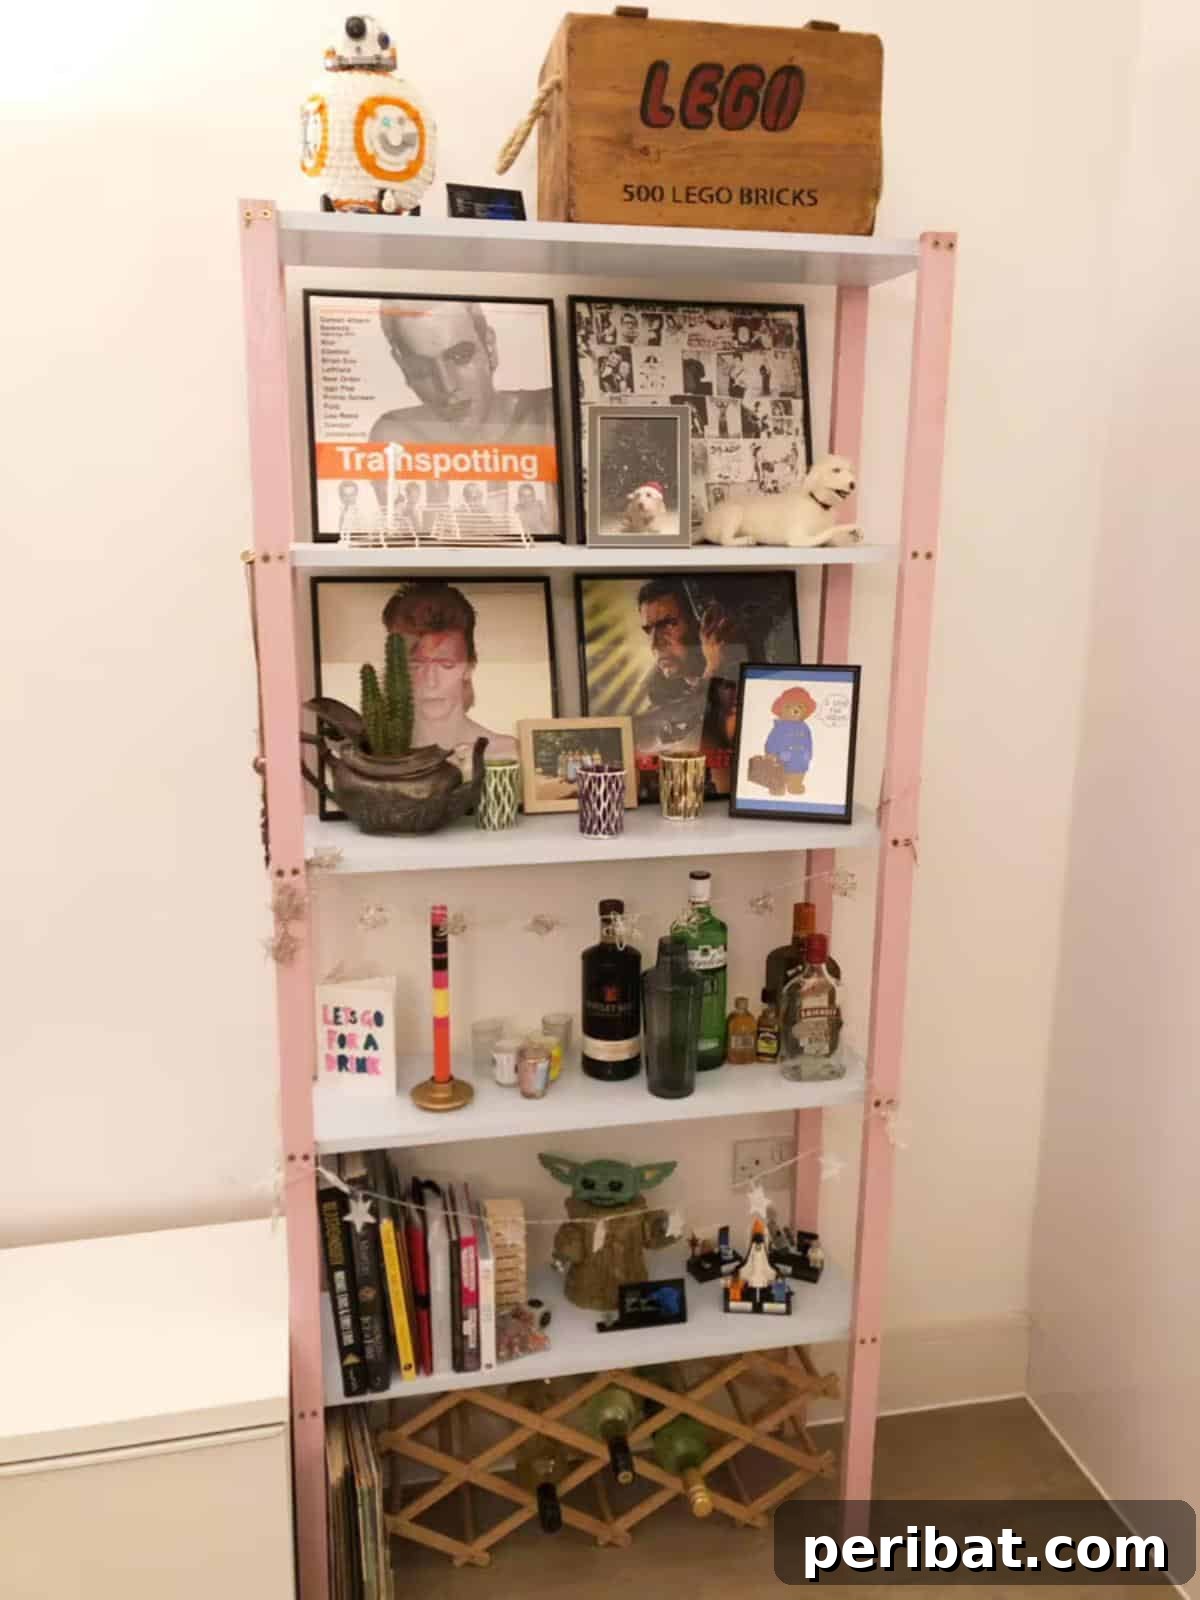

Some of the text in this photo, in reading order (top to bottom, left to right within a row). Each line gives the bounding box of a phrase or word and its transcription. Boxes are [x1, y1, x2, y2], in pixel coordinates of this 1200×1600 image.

[640, 59, 805, 132] LEGO
[623, 184, 818, 207] 500 LEGO BRICKS
[336, 445, 538, 480] Transpotting
[361, 1008, 384, 1028] GO
[363, 1033, 379, 1051] A
